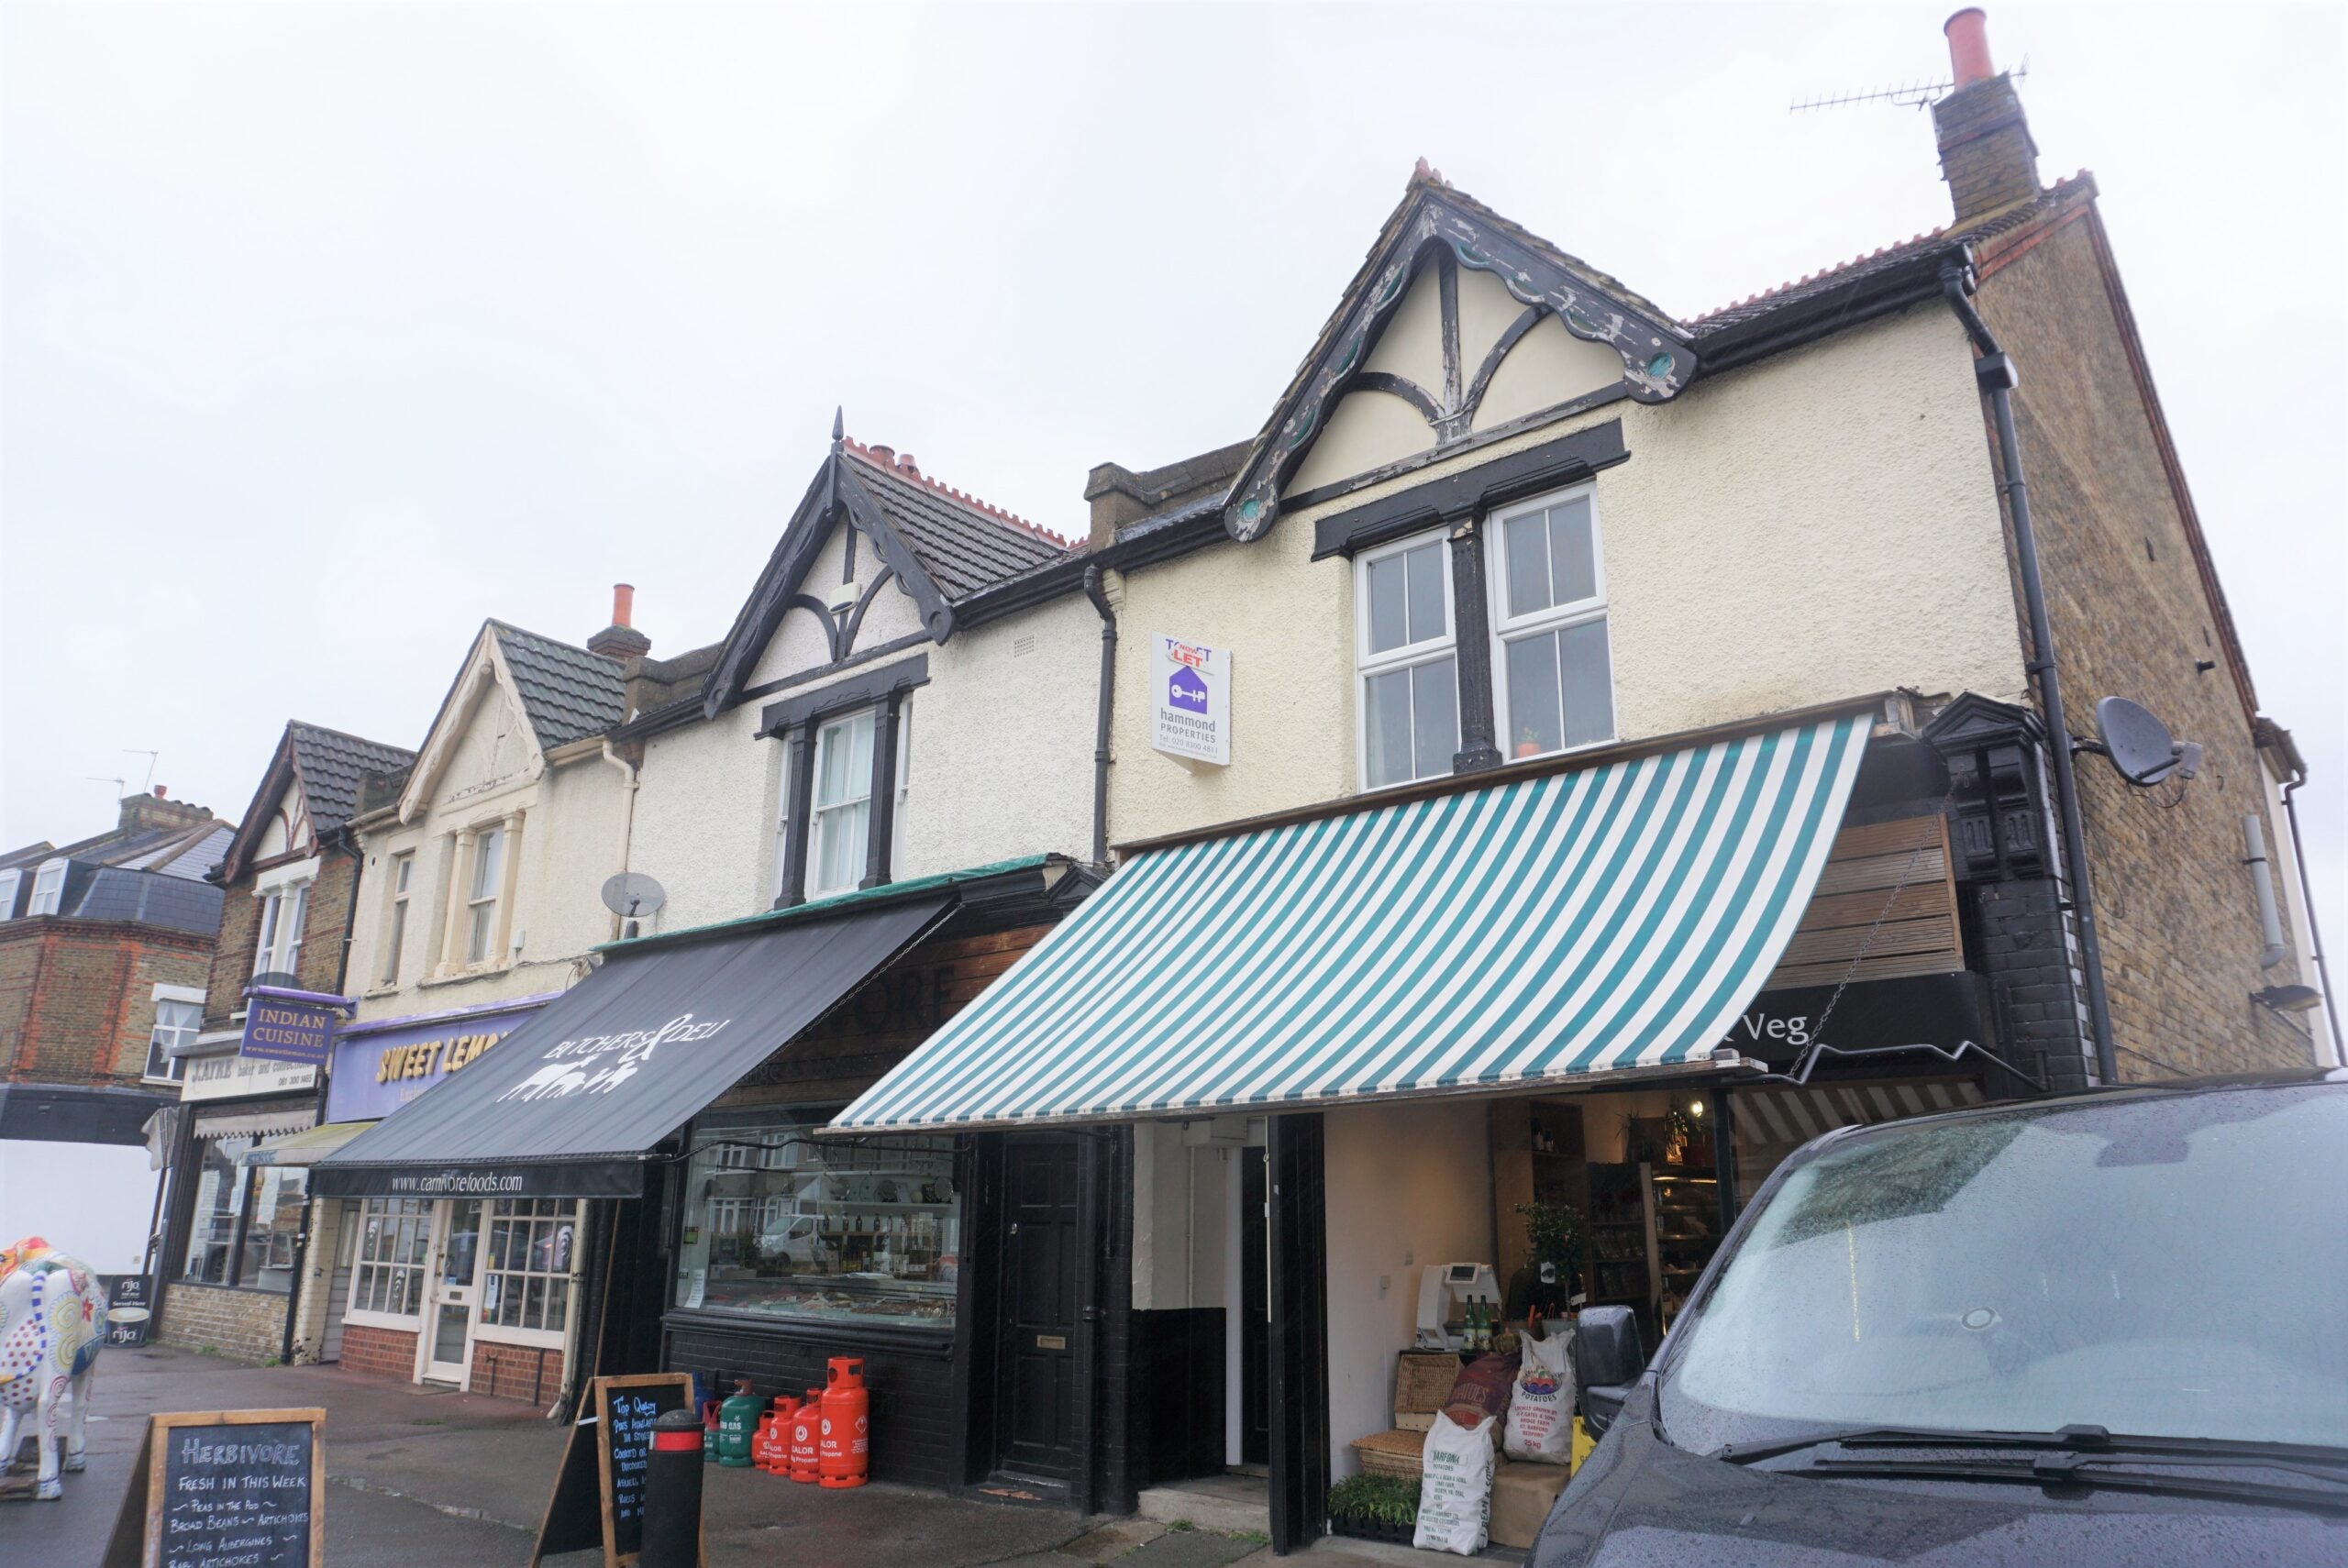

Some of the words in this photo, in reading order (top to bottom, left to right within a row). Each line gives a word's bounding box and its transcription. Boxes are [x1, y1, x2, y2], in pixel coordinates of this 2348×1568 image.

[1173, 649, 1203, 668] LET
[1180, 644, 1198, 654] NOW
[1160, 708, 1215, 732] hammond
[1160, 723, 1215, 744] PROPERTIES
[258, 1009, 327, 1029] INDIAN
[1744, 1012, 1810, 1045] Veg
[252, 1027, 325, 1047] CUISINE
[543, 1030, 656, 1059] BUTCHERS
[662, 1020, 731, 1043] DELI
[376, 1040, 443, 1084] SWEET
[442, 1032, 511, 1073] LEM
[258, 1062, 270, 1075] and
[393, 1171, 523, 1192] www.carnivorefoods.com
[1522, 1391, 1557, 1402] POTATOES
[182, 1438, 301, 1466] HERBIVORE
[792, 1445, 814, 1454] CALOR
[178, 1476, 215, 1492] FRESH
[222, 1477, 237, 1490] IN
[241, 1474, 270, 1489] THIS
[272, 1474, 306, 1489] WEEK
[191, 1499, 213, 1512] PEAS
[216, 1503, 225, 1511] IN
[227, 1500, 241, 1511] THE
[170, 1518, 203, 1534] BROAD
[206, 1514, 239, 1530] BEANS
[258, 1512, 309, 1527] ARTICHOKES
[185, 1540, 213, 1553] LONG
[217, 1536, 272, 1552] AUBERGINES
[199, 1553, 260, 1568] ARTICHOKES
